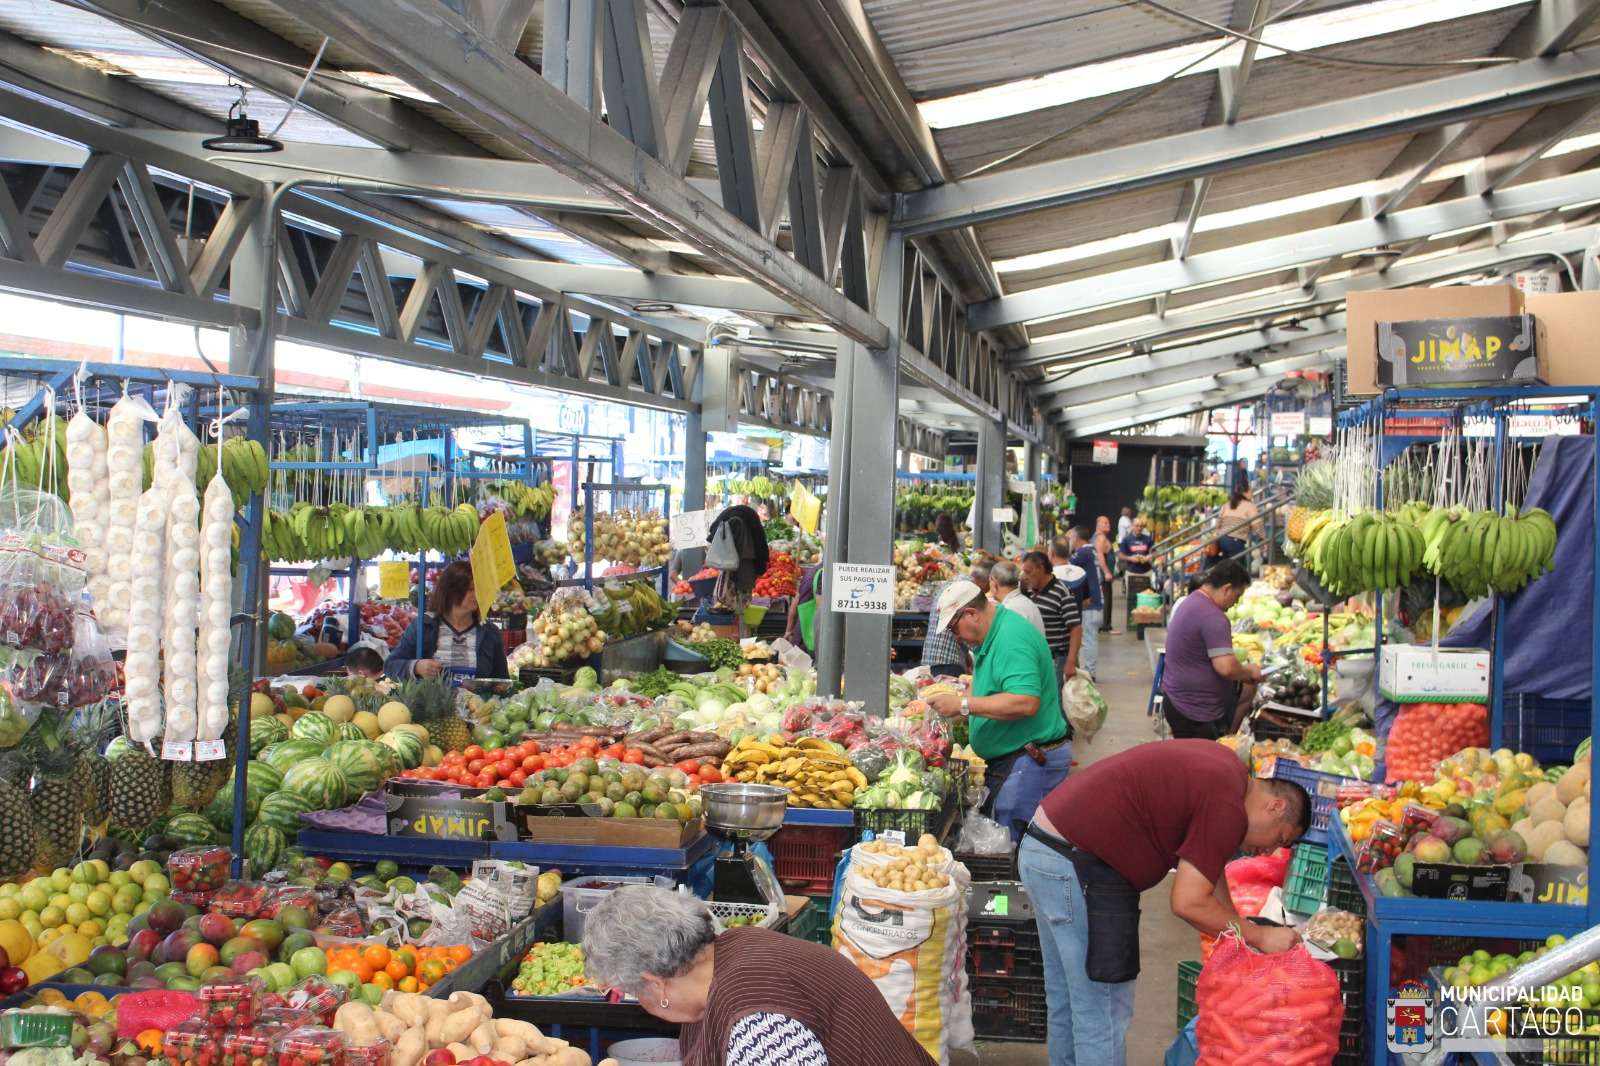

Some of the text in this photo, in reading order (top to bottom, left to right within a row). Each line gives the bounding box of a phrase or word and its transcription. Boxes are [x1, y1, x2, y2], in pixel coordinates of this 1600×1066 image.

[1411, 336, 1502, 363] JIMAP
[837, 600, 887, 610] 8711-9338
[414, 816, 490, 837] JIMAP
